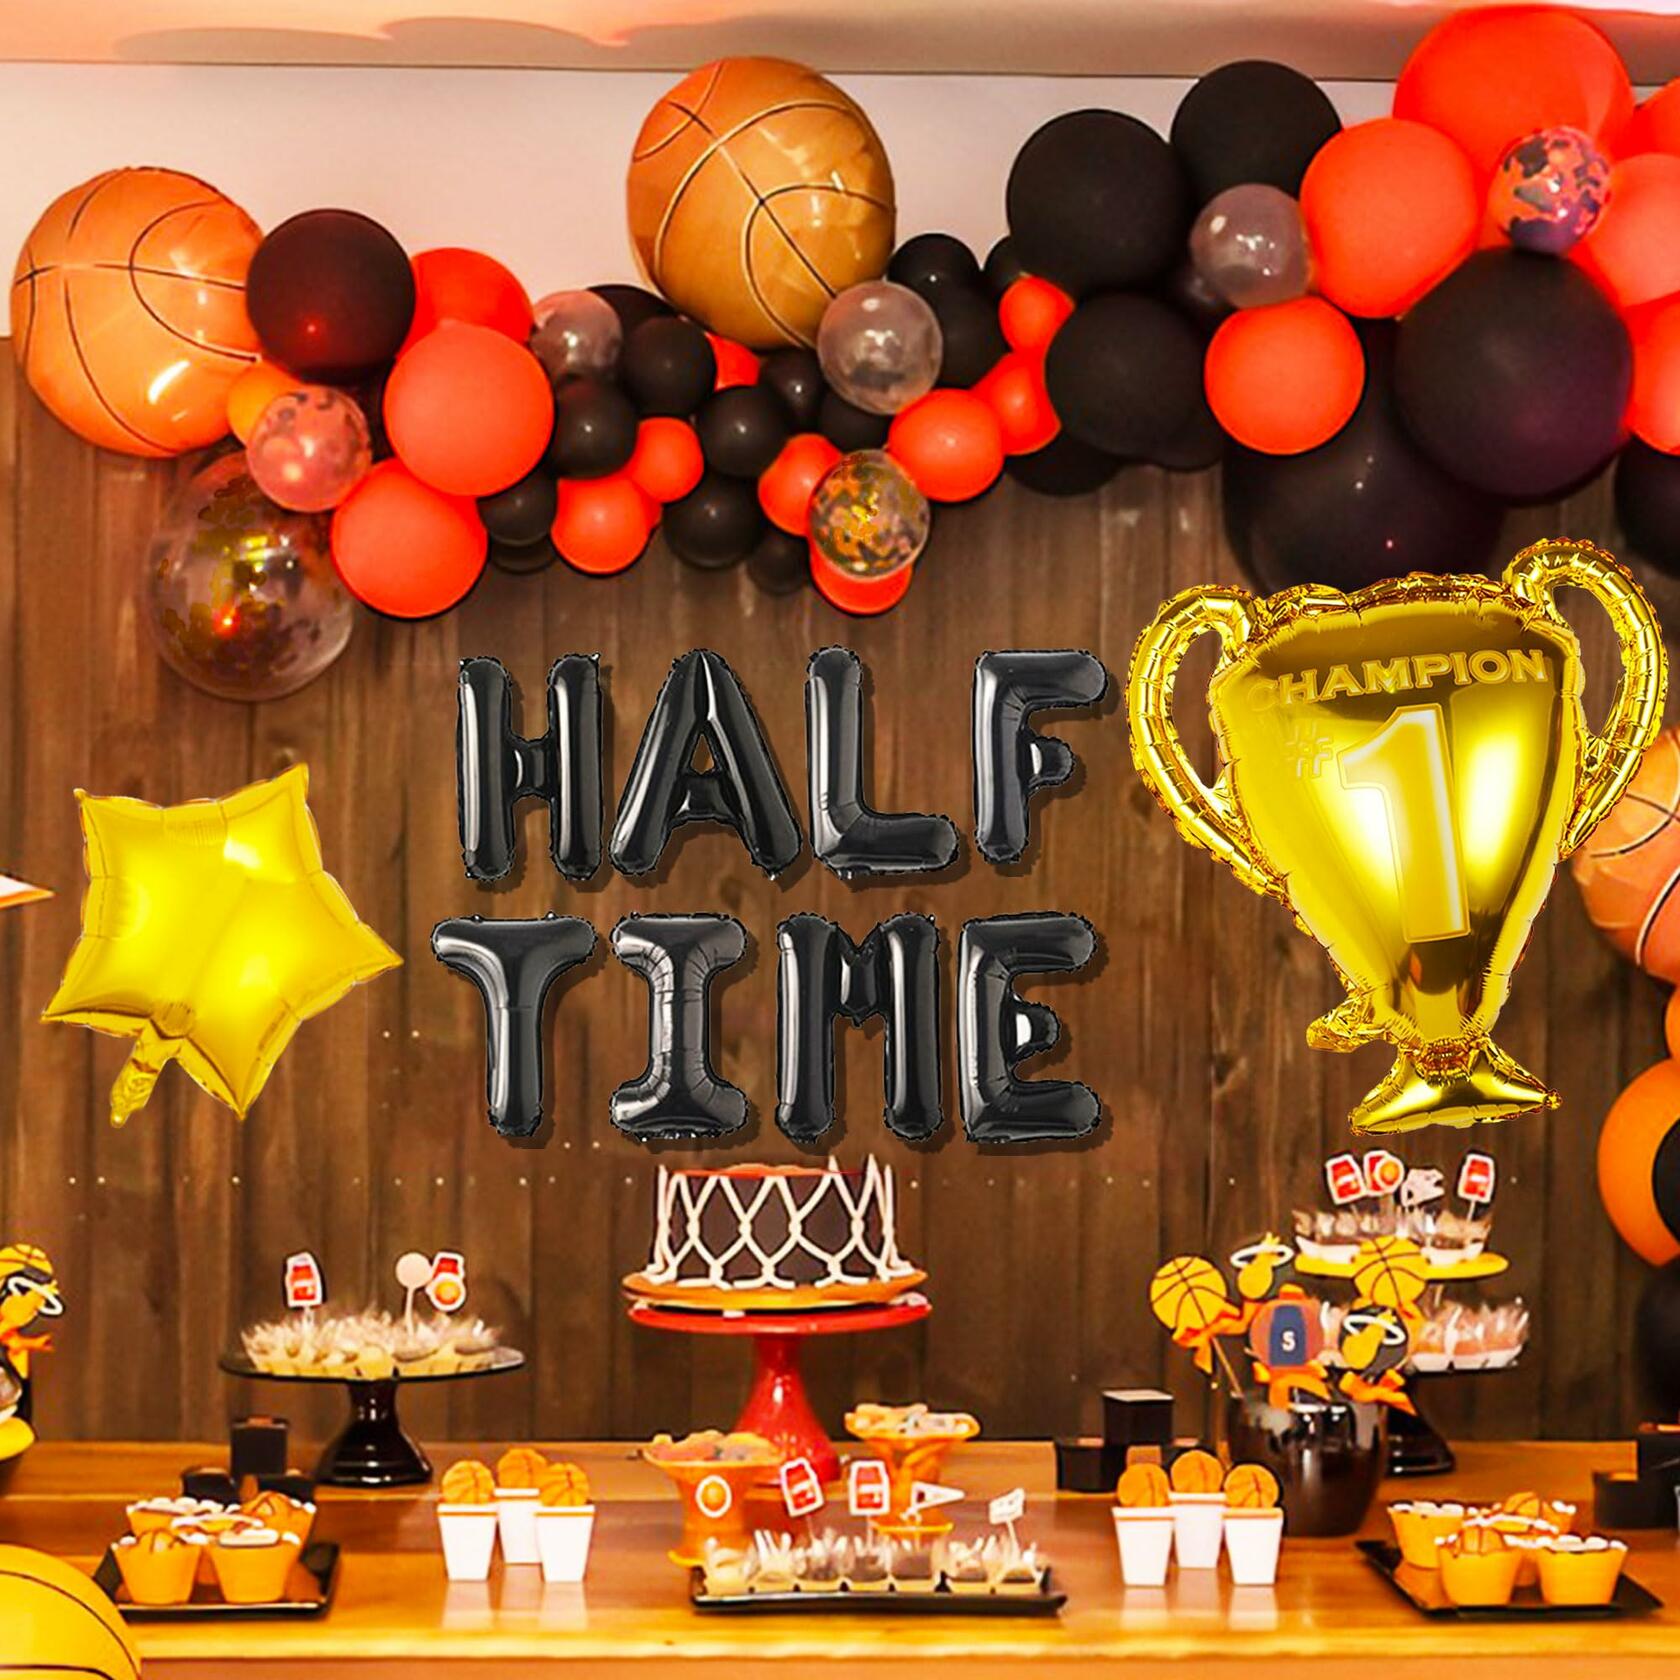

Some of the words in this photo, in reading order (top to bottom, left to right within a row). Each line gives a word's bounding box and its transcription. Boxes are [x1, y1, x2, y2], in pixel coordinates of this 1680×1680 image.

[457, 646, 1108, 880] HALF
[1247, 650, 1548, 711] CHAMPION
[431, 912, 1101, 1142] TIME
